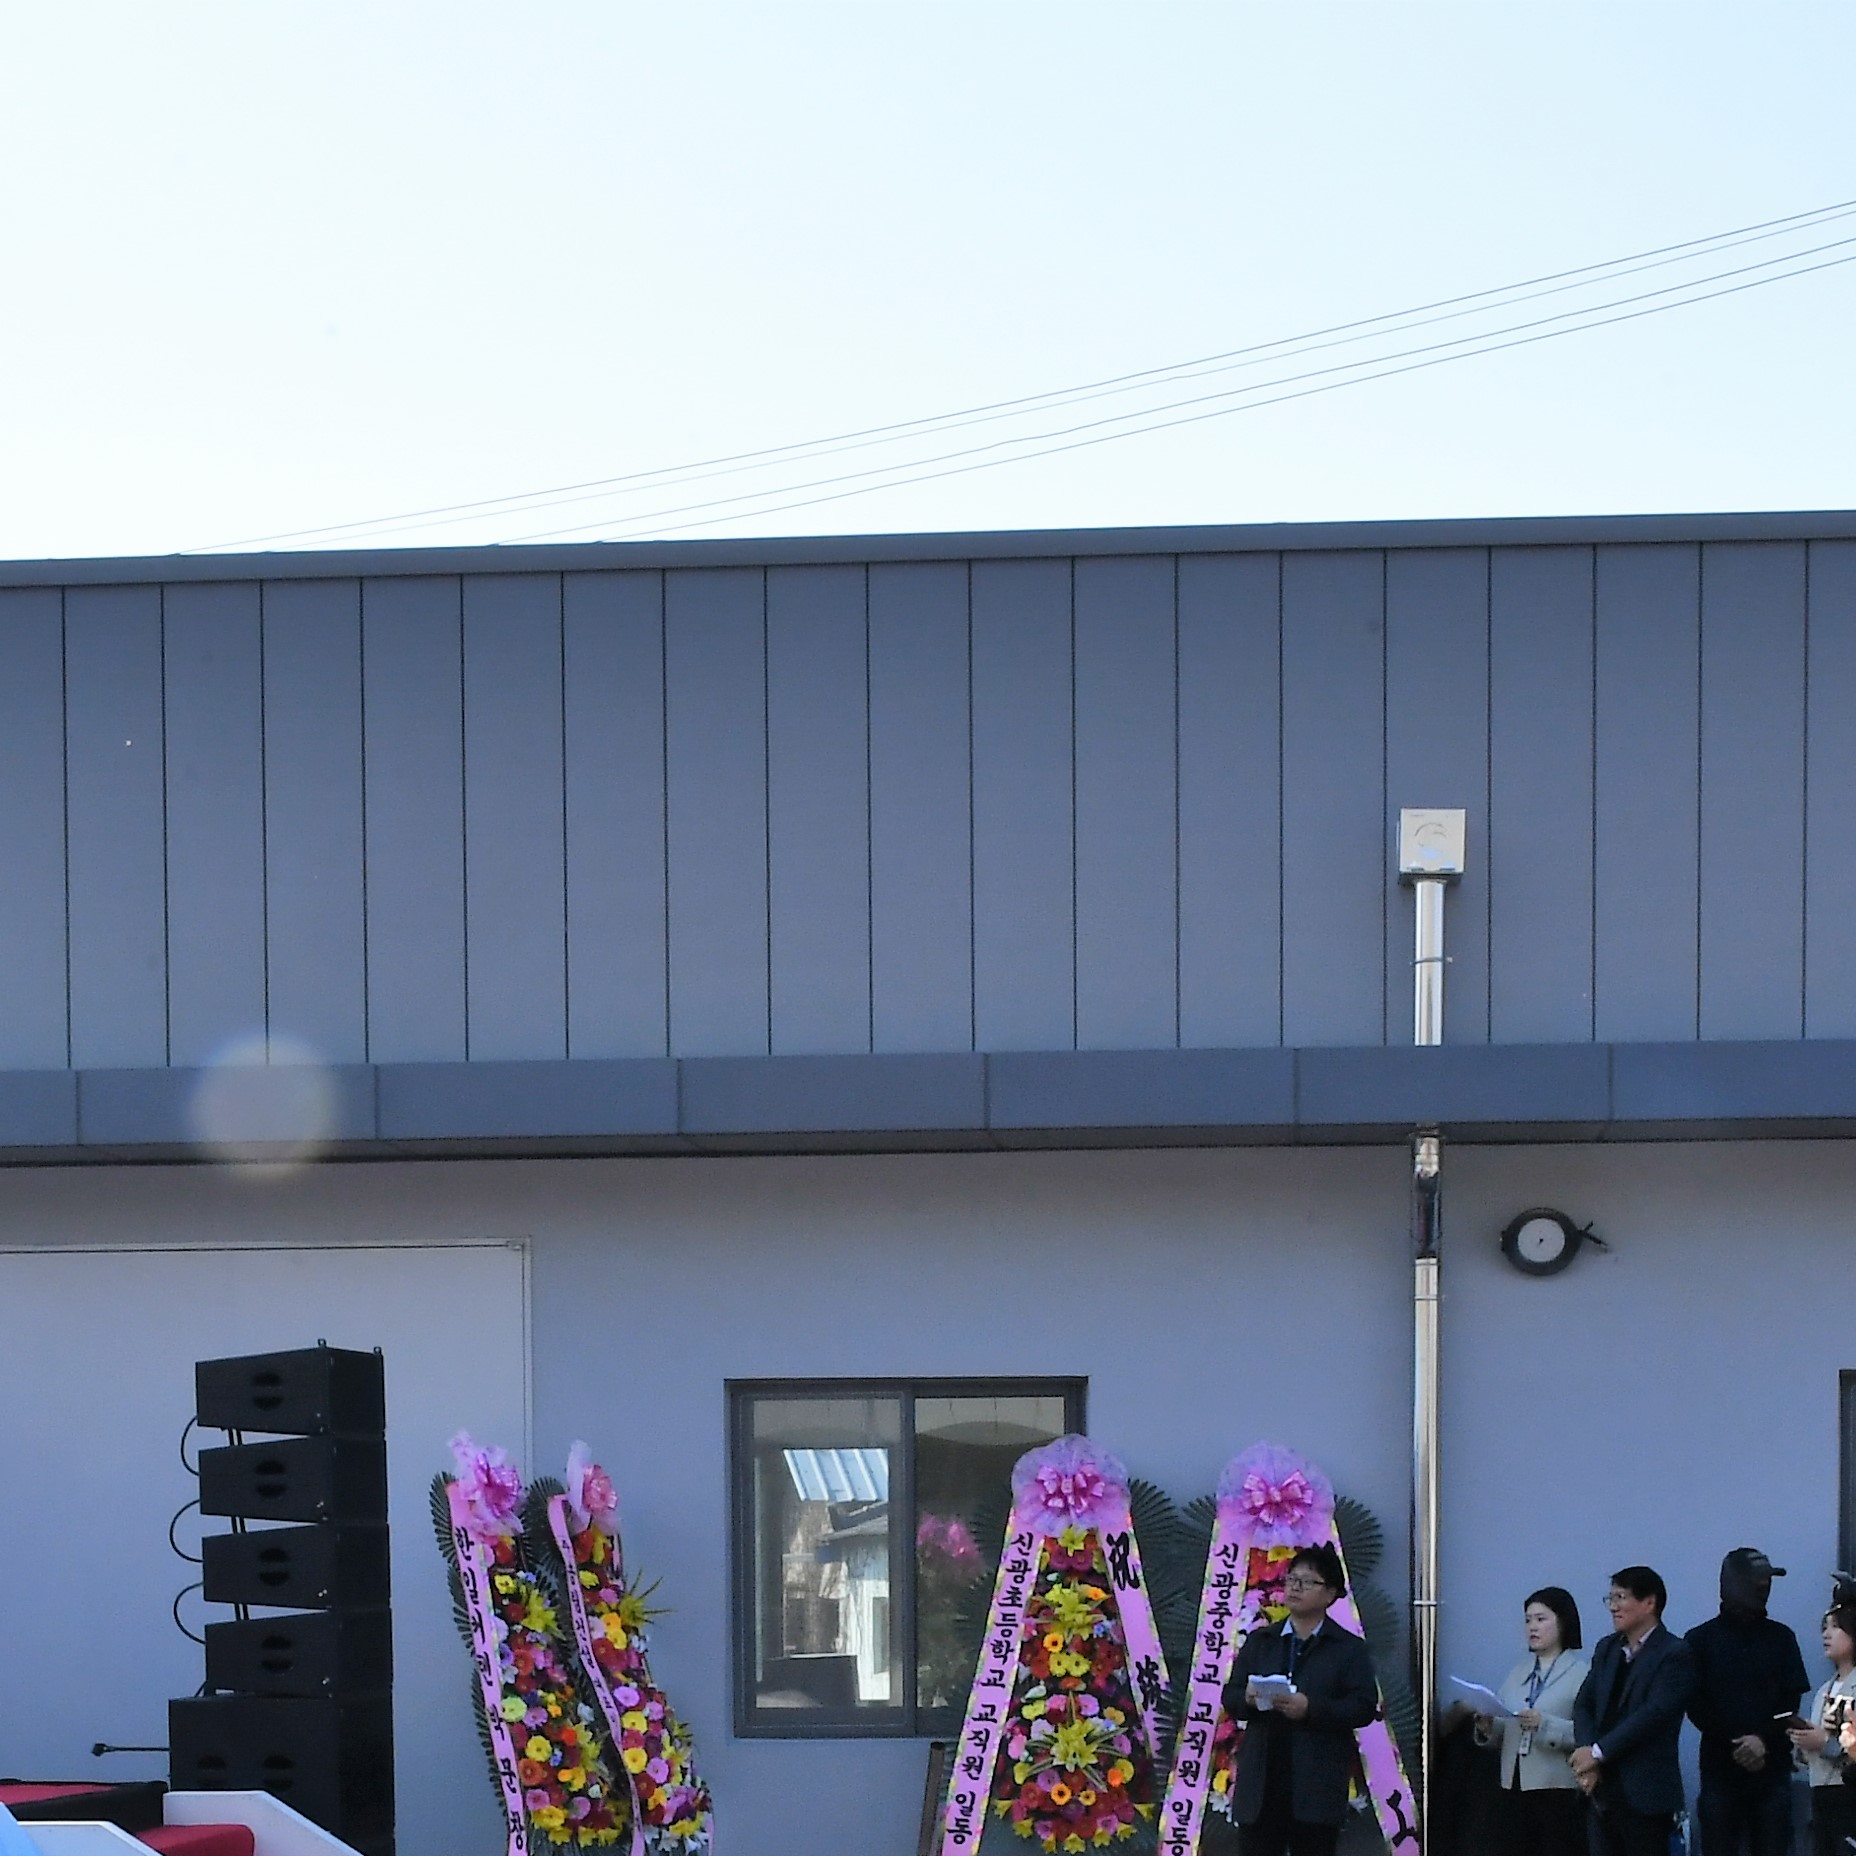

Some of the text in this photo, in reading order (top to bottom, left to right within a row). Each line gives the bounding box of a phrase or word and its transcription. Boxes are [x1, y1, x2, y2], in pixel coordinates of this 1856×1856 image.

[980, 1531, 1034, 1690] 신광초등학교
[1195, 1542, 1240, 1686] 신광중학교
[961, 1703, 999, 1786] 교직원
[1176, 1702, 1215, 1787] 교직원
[946, 1791, 976, 1846] 일동
[1164, 1798, 1193, 1856] 일동
